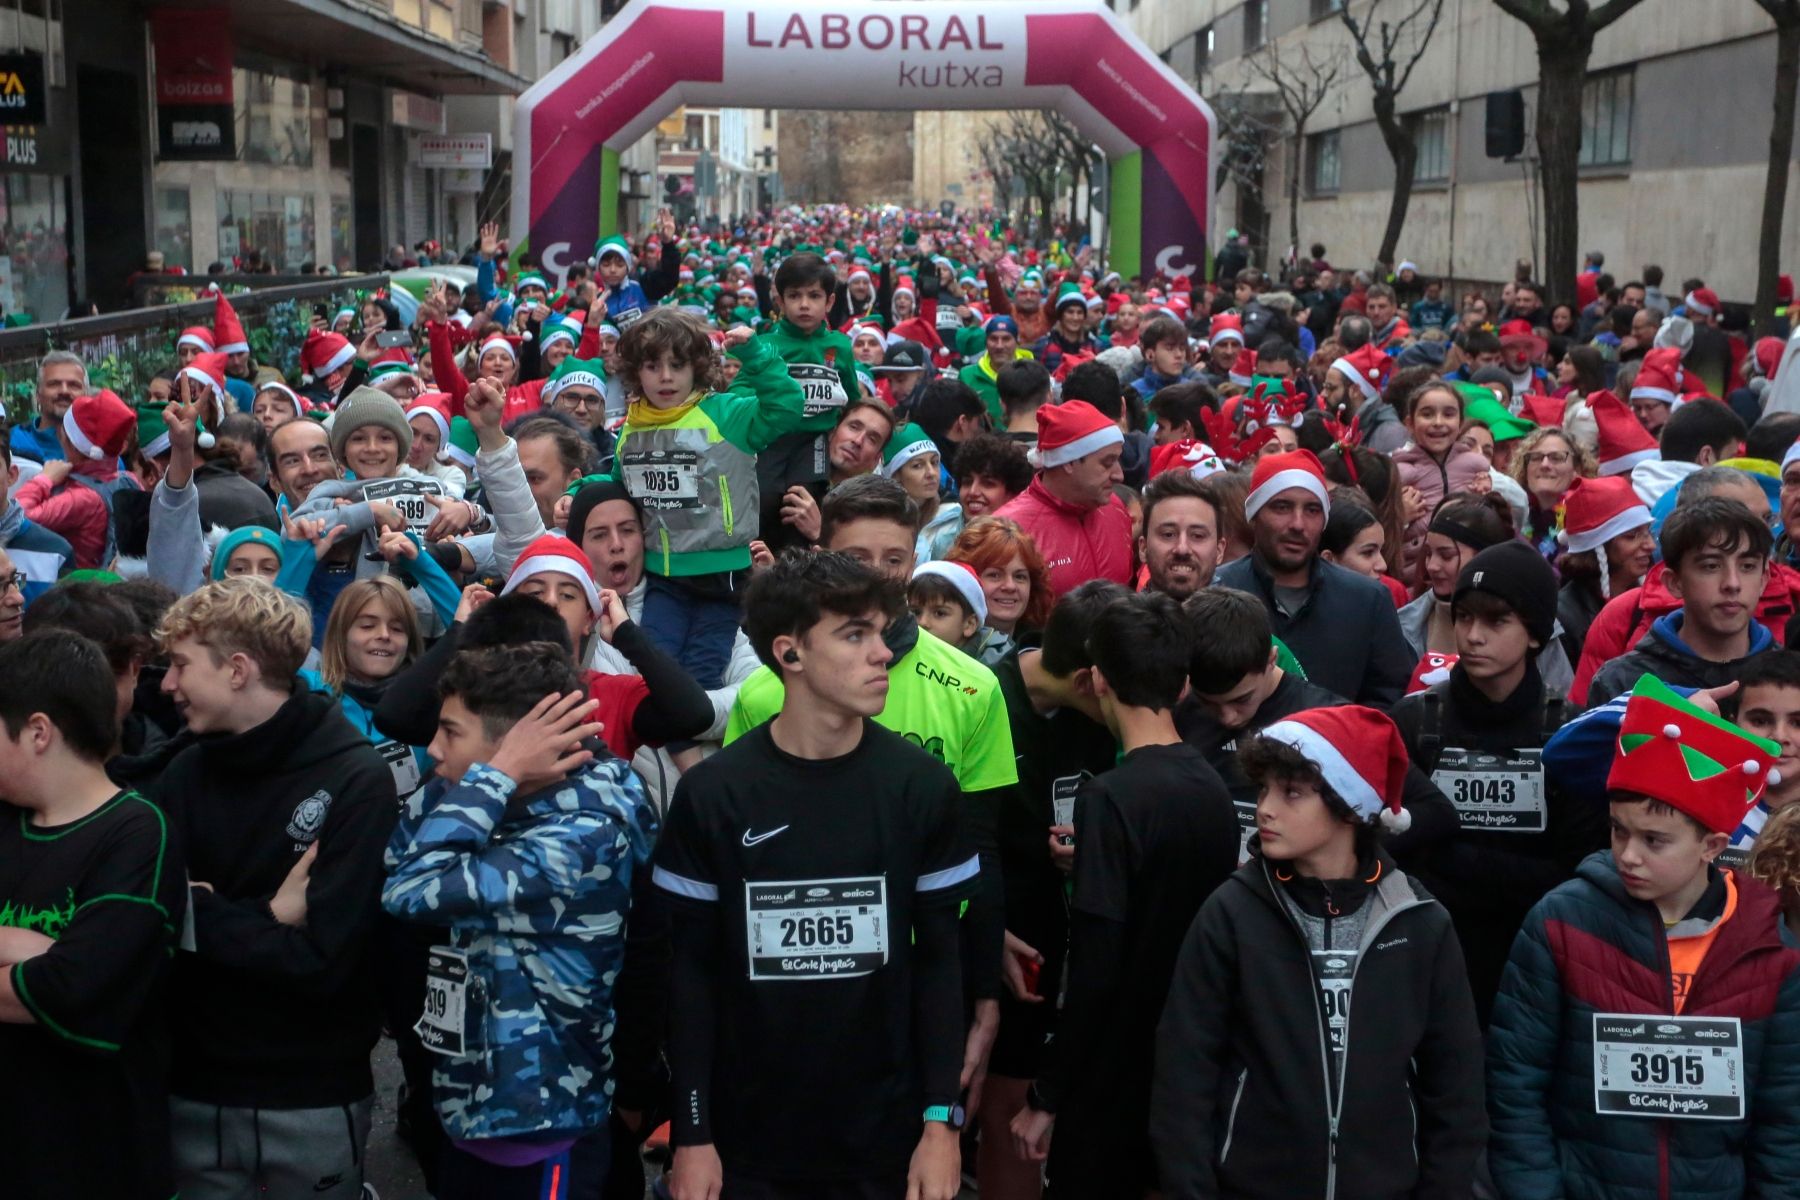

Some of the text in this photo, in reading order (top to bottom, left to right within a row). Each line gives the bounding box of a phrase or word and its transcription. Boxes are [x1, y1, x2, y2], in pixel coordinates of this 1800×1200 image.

[747, 12, 1004, 50] LABORAL
[899, 60, 1004, 88] kutxa
[7, 138, 37, 164] PLUS
[803, 384, 833, 400] 1748
[642, 471, 680, 492] 1035
[916, 662, 960, 691] C.N.P.
[1454, 779, 1515, 804] 3043
[756, 894, 784, 902] LABORAL
[780, 915, 854, 947] 2665
[793, 959, 818, 970] Corte
[1631, 1052, 1704, 1085] 3915
[691, 1090, 700, 1125] KIPSTA
[1641, 1095, 1668, 1108] Corte
